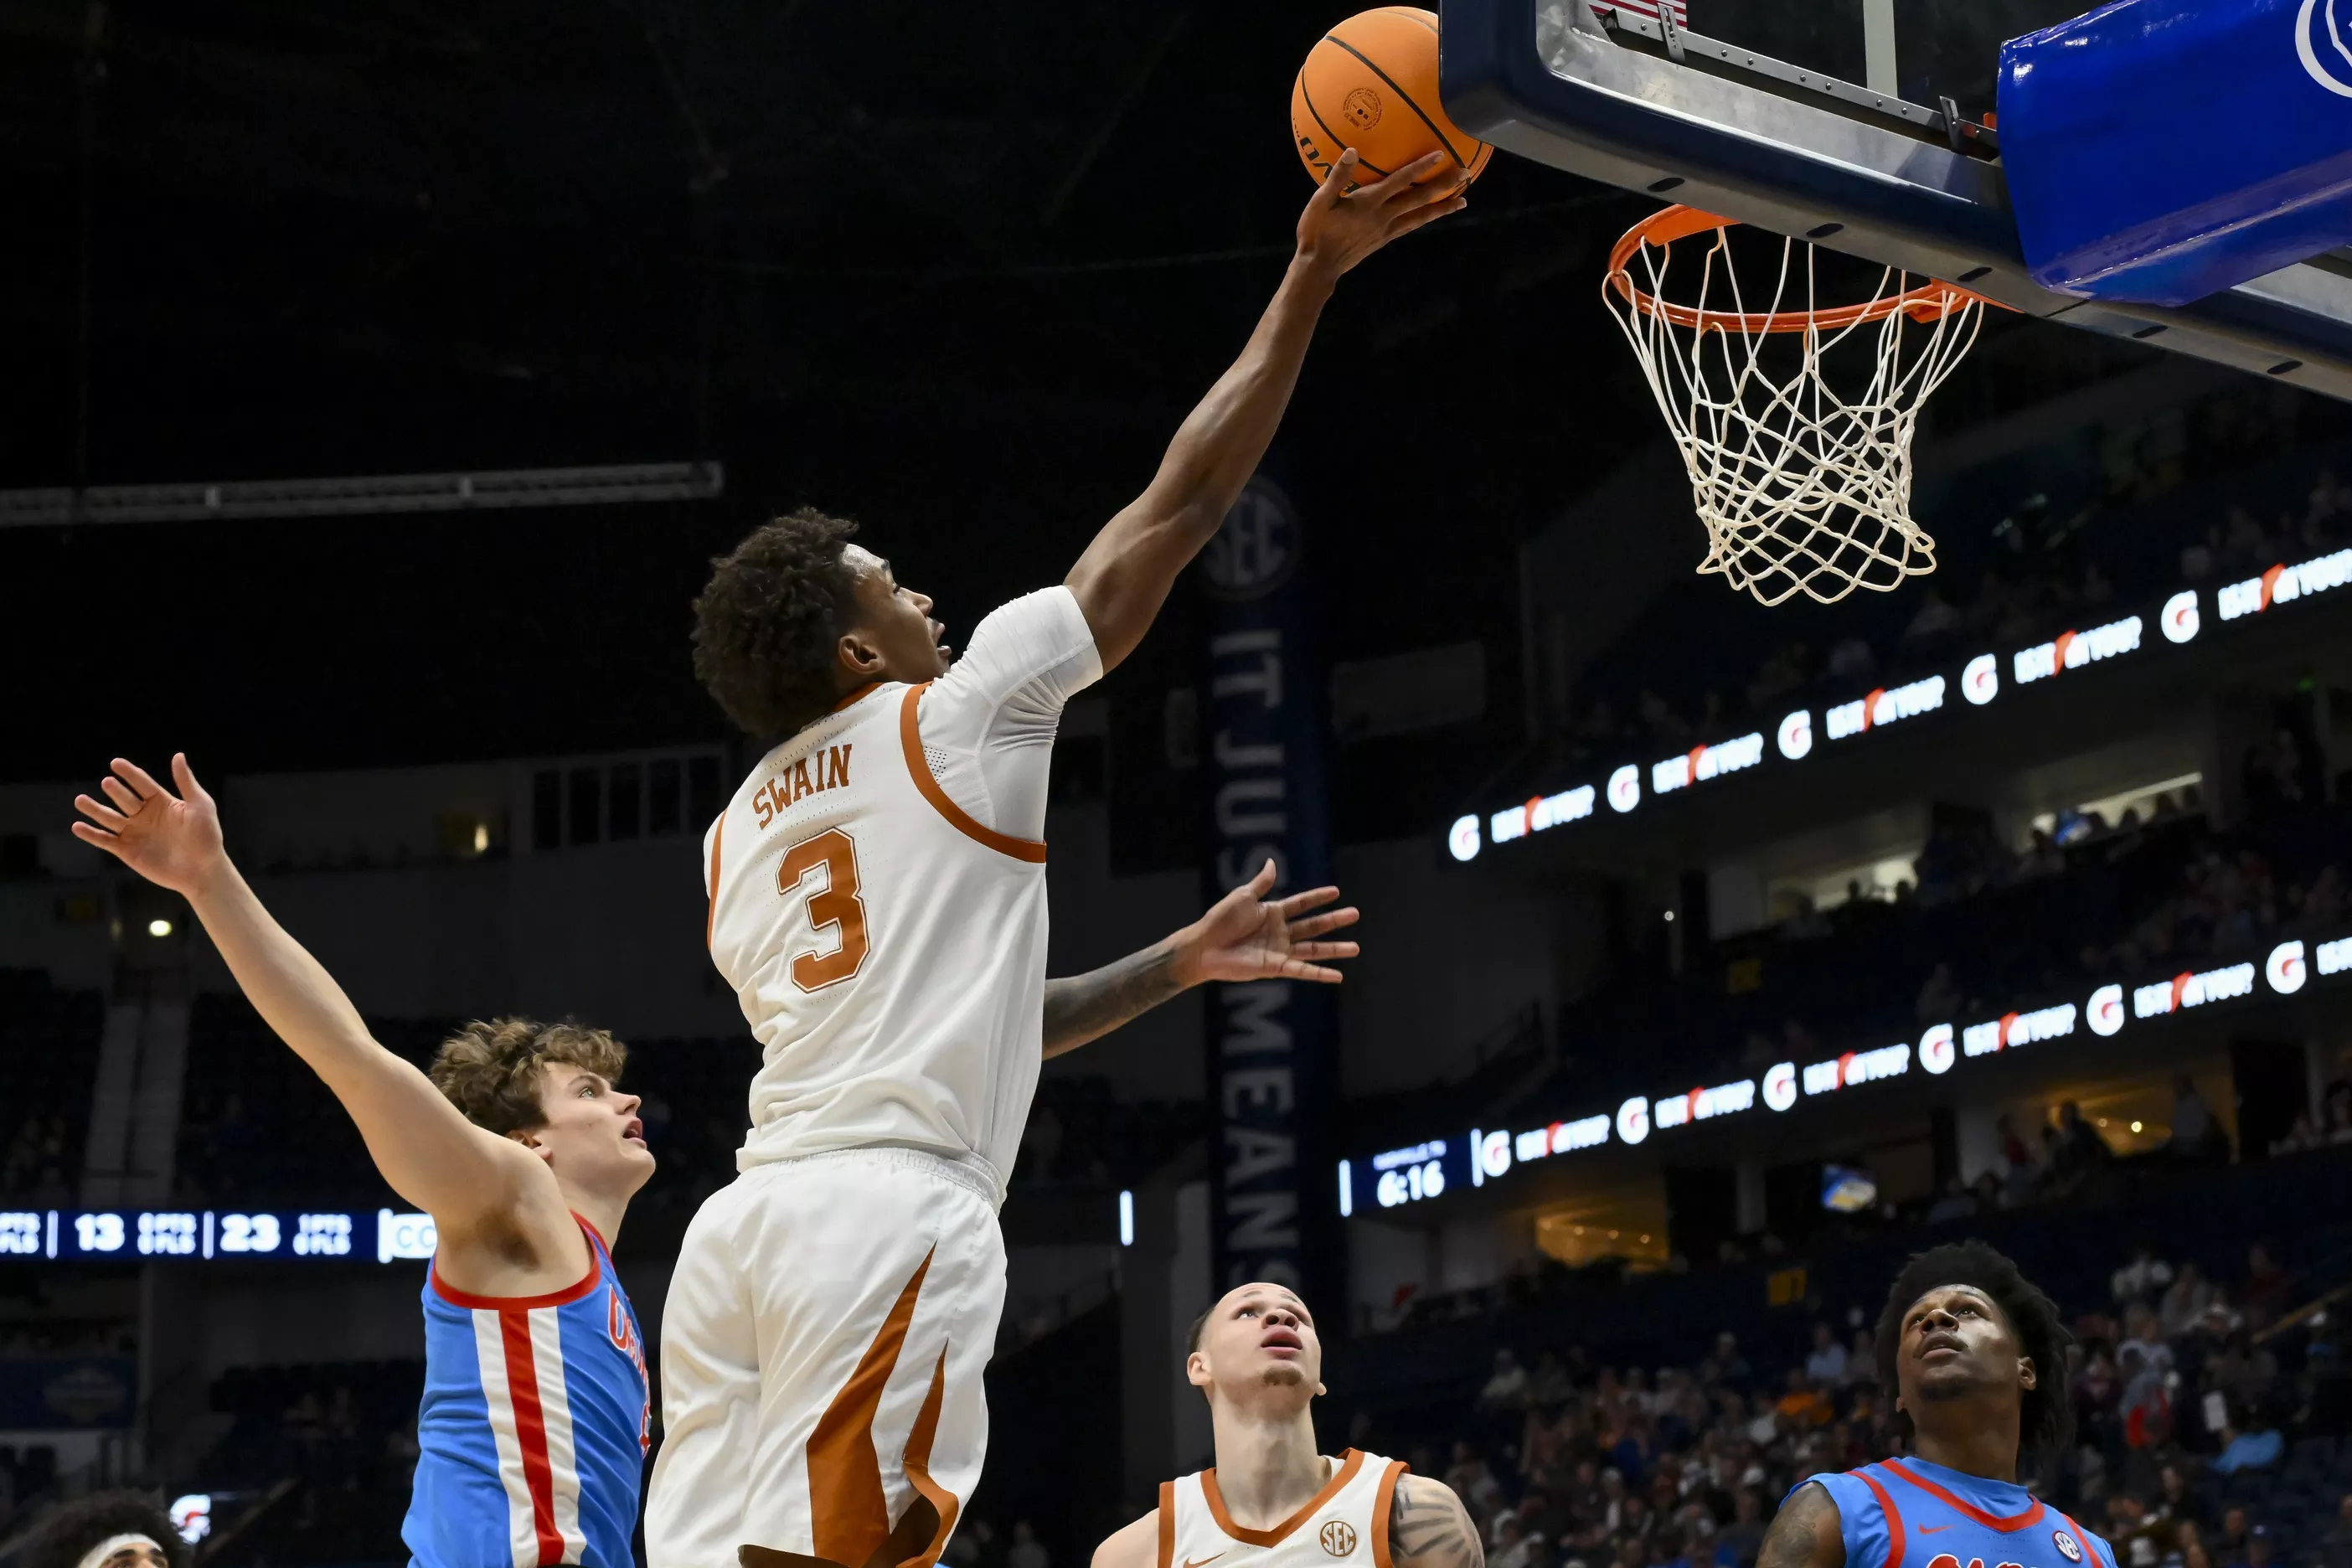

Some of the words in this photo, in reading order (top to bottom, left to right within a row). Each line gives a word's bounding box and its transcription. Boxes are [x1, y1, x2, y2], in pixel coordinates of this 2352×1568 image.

[2161, 590, 2200, 643] G
[1210, 630, 1283, 709] IT
[1962, 653, 1999, 705] G
[1777, 709, 1812, 760] G
[752, 743, 853, 830] SWAIN
[1212, 711, 1288, 900] JUS
[1607, 763, 1640, 812] G
[1449, 814, 1480, 861] G
[775, 826, 871, 994] 3
[2266, 940, 2307, 994] G
[2086, 983, 2124, 1036] G
[1919, 1023, 1955, 1075] G
[1762, 1061, 1797, 1112] G
[1617, 1096, 1649, 1145] G
[1481, 1129, 1511, 1177] G
[1377, 1160, 1445, 1208] 6:16
[75, 1213, 126, 1252] 13
[219, 1213, 281, 1252] 23
[1322, 1522, 1355, 1555] SEC
